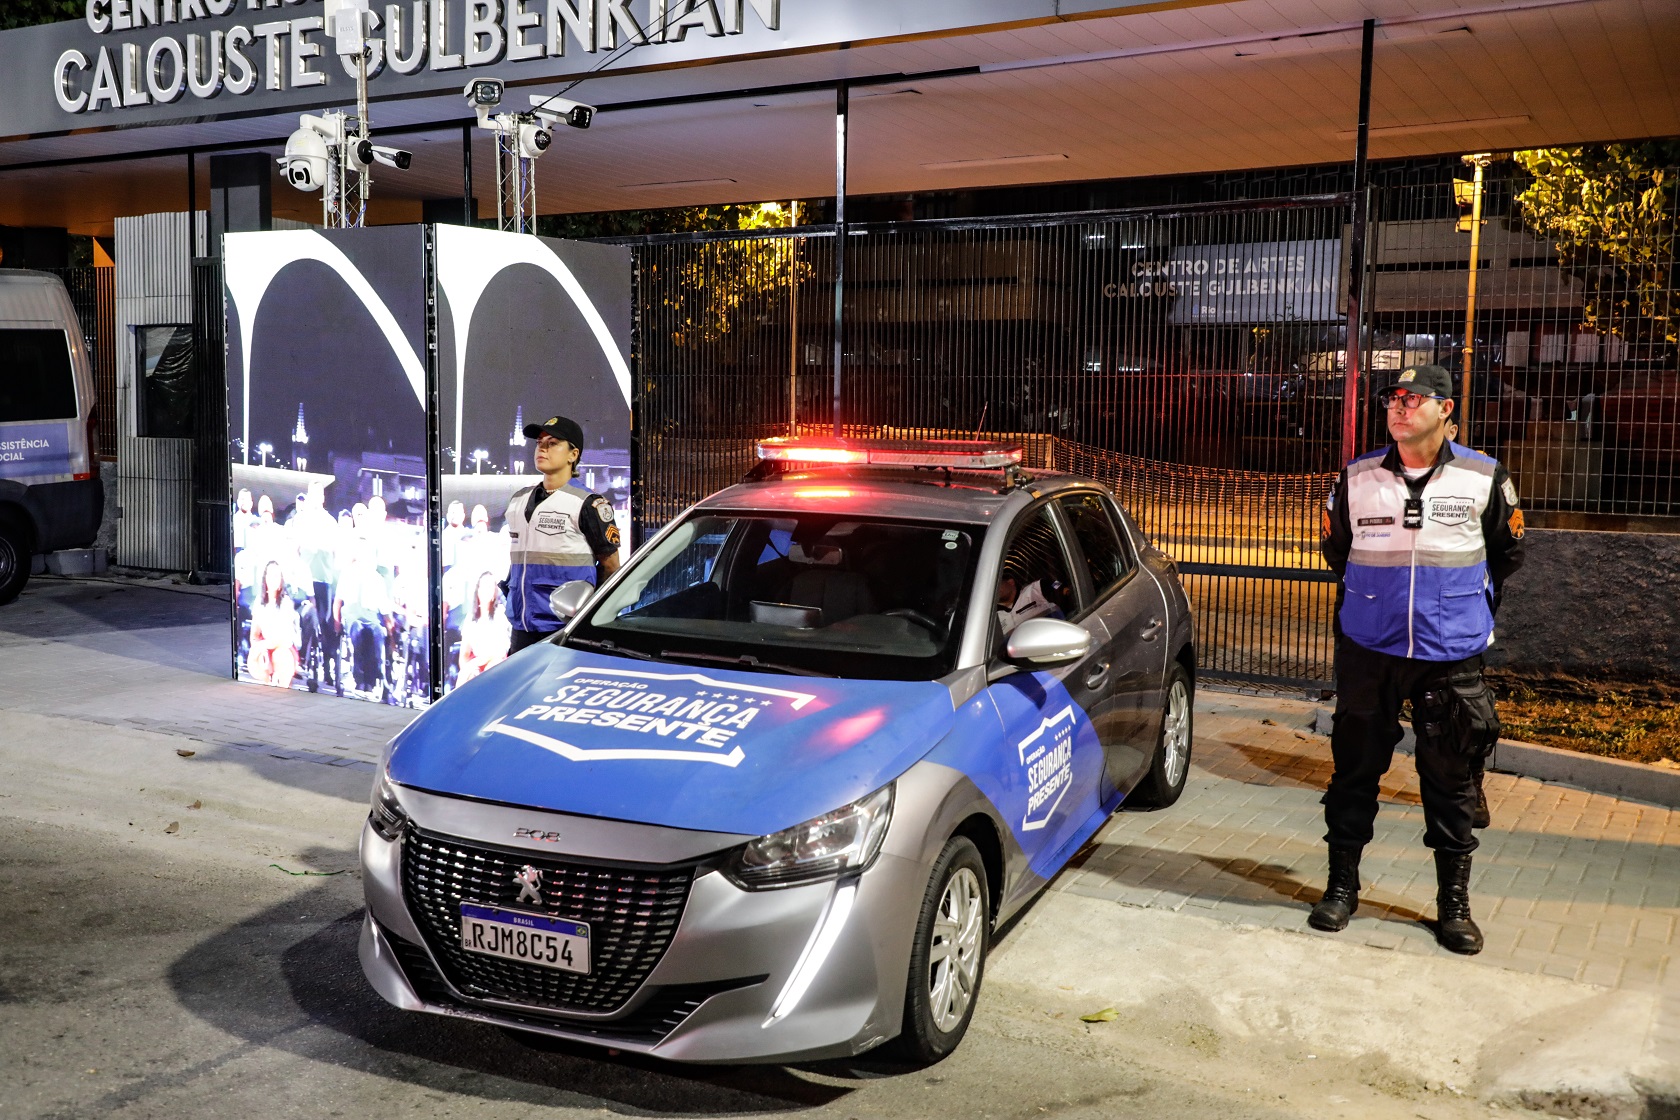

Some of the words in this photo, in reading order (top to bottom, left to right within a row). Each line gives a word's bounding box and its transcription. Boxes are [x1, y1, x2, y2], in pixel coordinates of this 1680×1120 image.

[53, 16, 326, 114] CALOUSTE
[1131, 258, 1209, 277] CENTRO
[1215, 258, 1240, 275] DE
[1243, 255, 1305, 274] ARTES
[1103, 280, 1201, 298] CALOUSTE
[1206, 276, 1336, 296] GULBENKIAN
[1201, 305, 1216, 314] Rio
[0, 438, 50, 451] SISTÊNCIA
[539, 517, 566, 526] SEGURANÇA
[574, 678, 649, 690] OPERAÇÃO
[543, 685, 760, 730] SEGURANÇA
[514, 705, 737, 748] PRESENTE
[1028, 735, 1072, 794] SEGURANÇA
[1027, 762, 1071, 816] PRESENTE
[512, 827, 561, 843] 208
[513, 917, 534, 926] BRASIL
[464, 938, 472, 947] BR
[472, 922, 573, 967] RJM8C54
